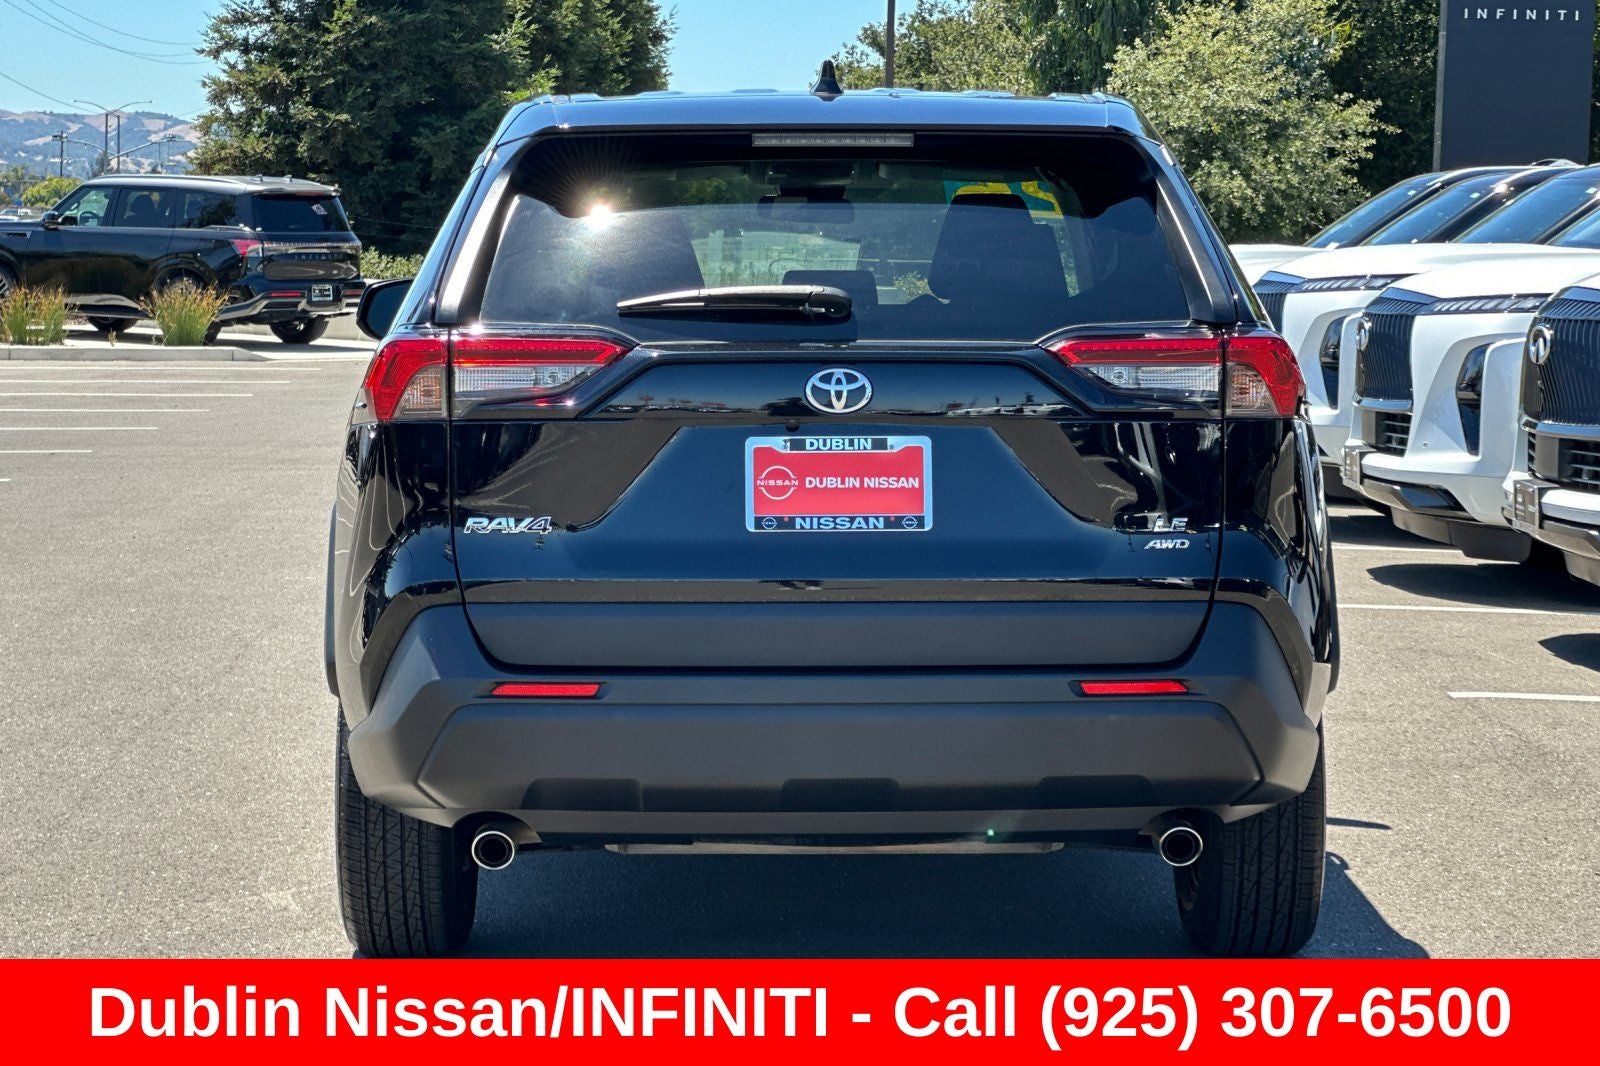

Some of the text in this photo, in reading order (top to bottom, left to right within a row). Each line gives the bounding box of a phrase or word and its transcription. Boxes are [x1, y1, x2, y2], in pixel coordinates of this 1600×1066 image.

[1463, 8, 1580, 21] INFINITI
[805, 438, 872, 451] DUBLIN
[757, 479, 799, 487] NISSAN
[805, 477, 919, 489] DUBLIN NISSAN
[463, 516, 553, 535] RAV4
[795, 517, 885, 530] NISSAN
[1143, 539, 1190, 550] AWD
